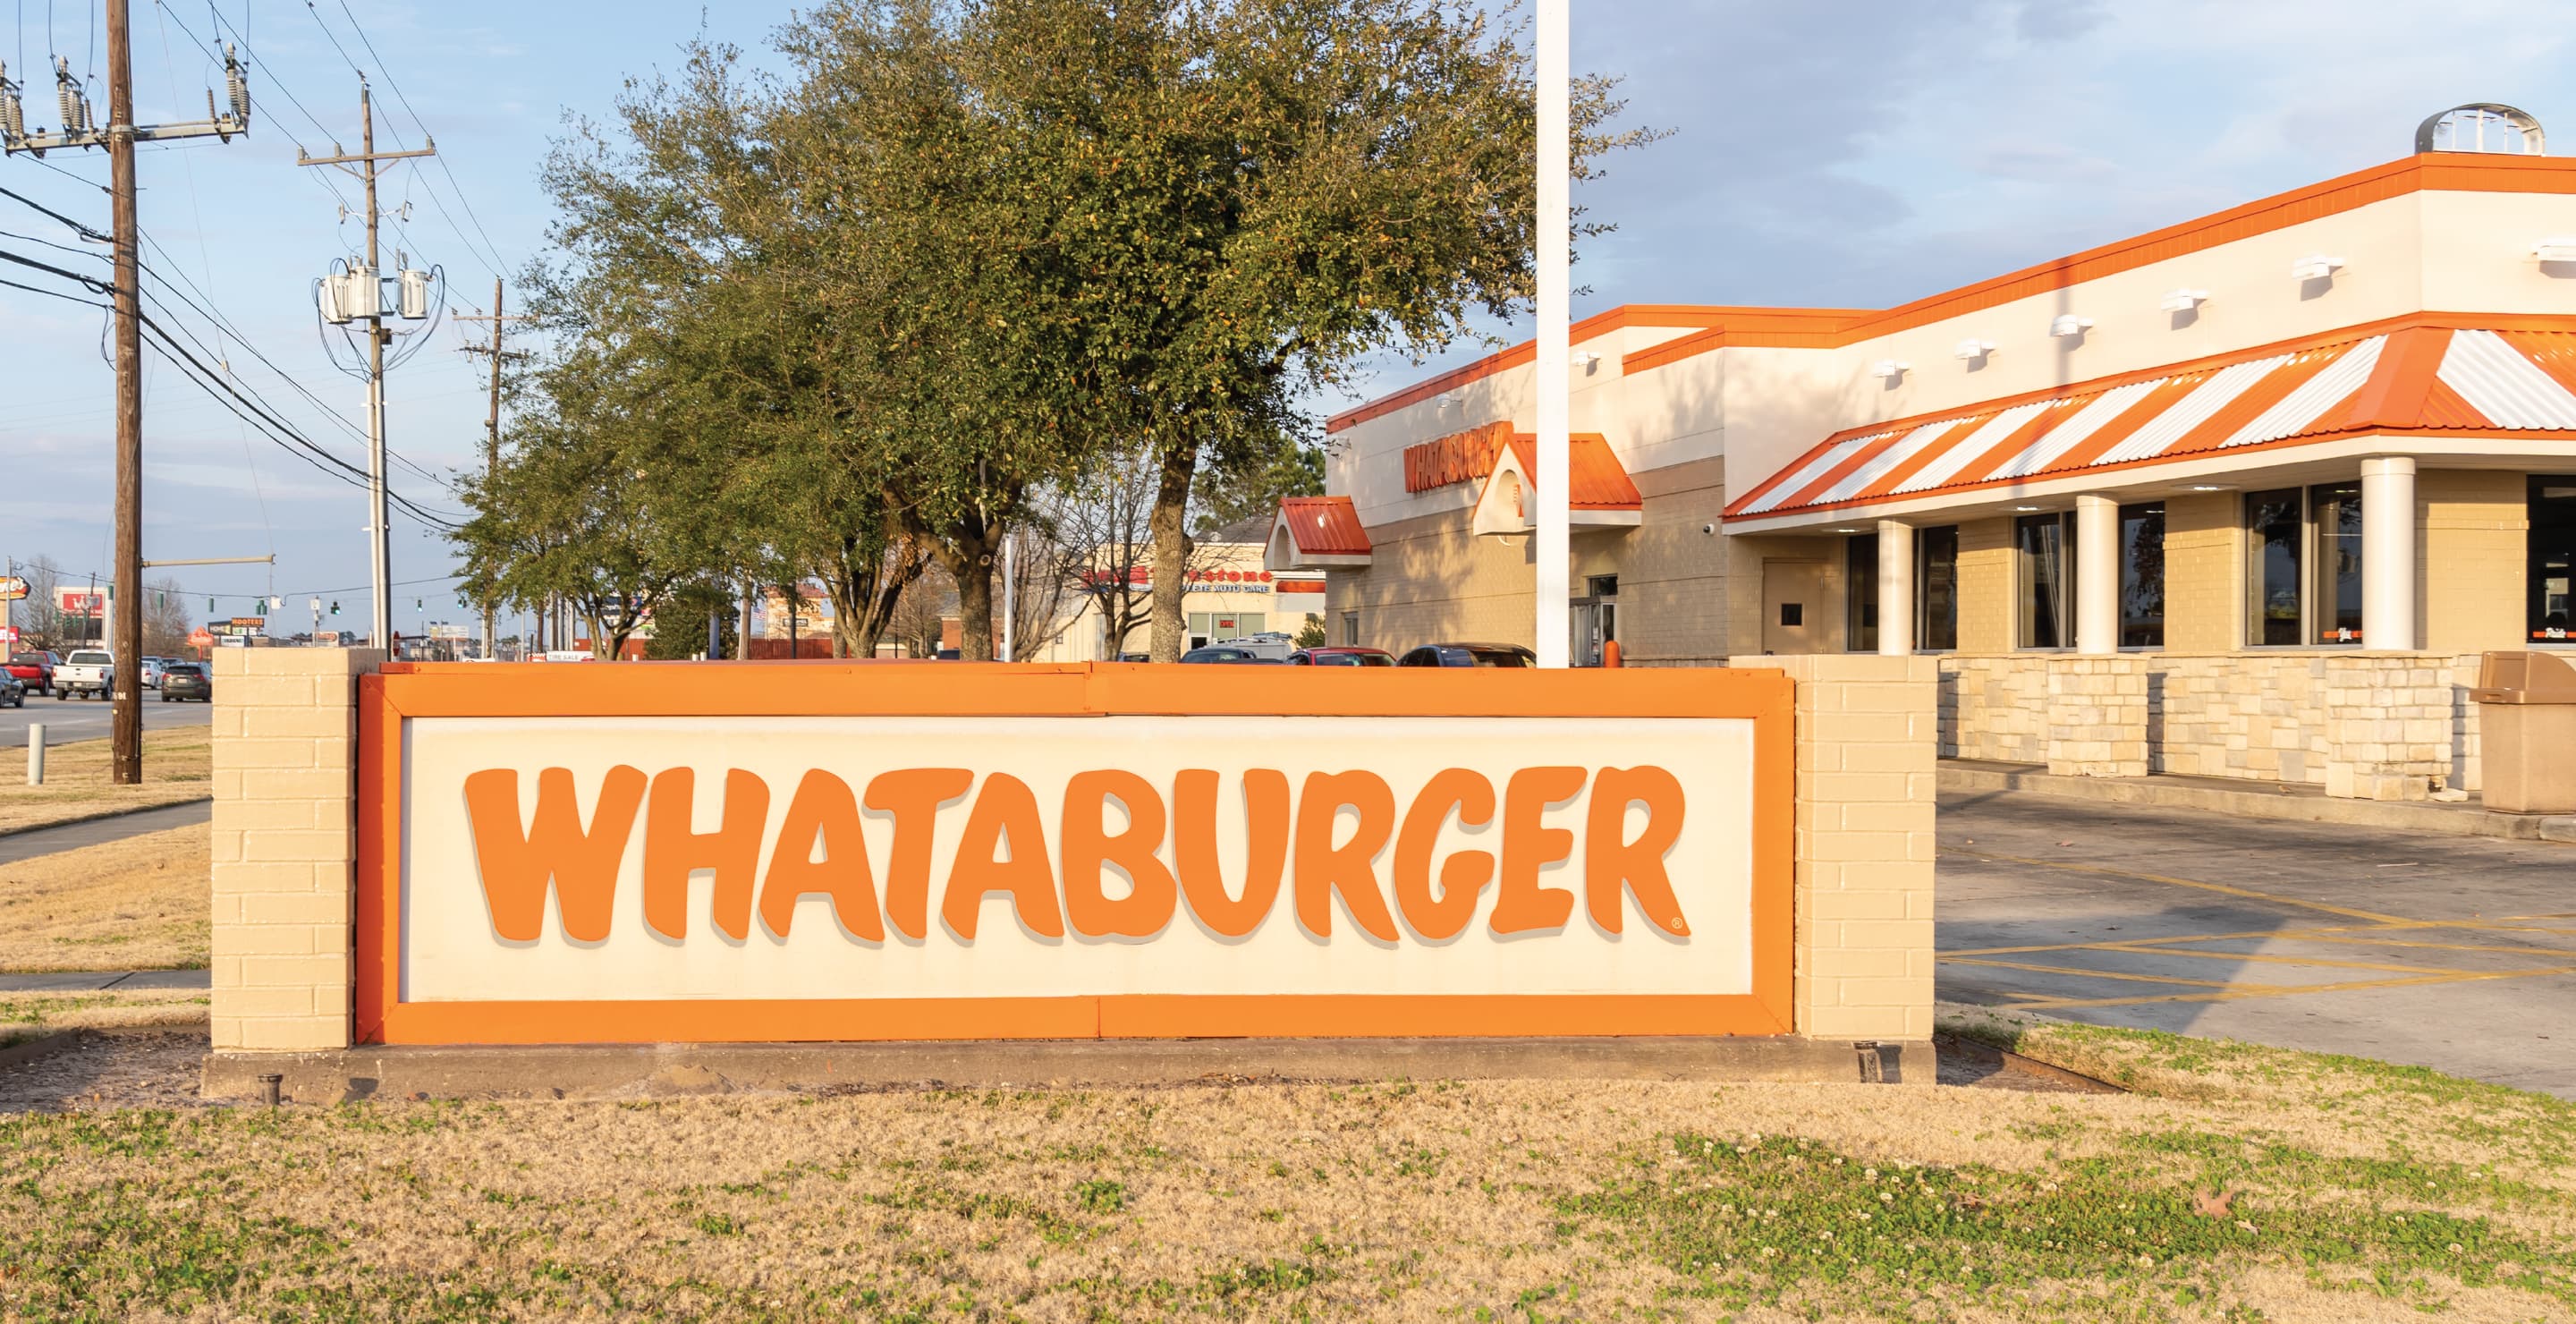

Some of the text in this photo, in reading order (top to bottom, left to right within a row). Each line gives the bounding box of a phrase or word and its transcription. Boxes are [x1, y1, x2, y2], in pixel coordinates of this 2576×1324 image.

[1214, 584, 1241, 593] AUTO
[1242, 584, 1271, 593] CARE
[464, 764, 1690, 941] WHATABURGER
